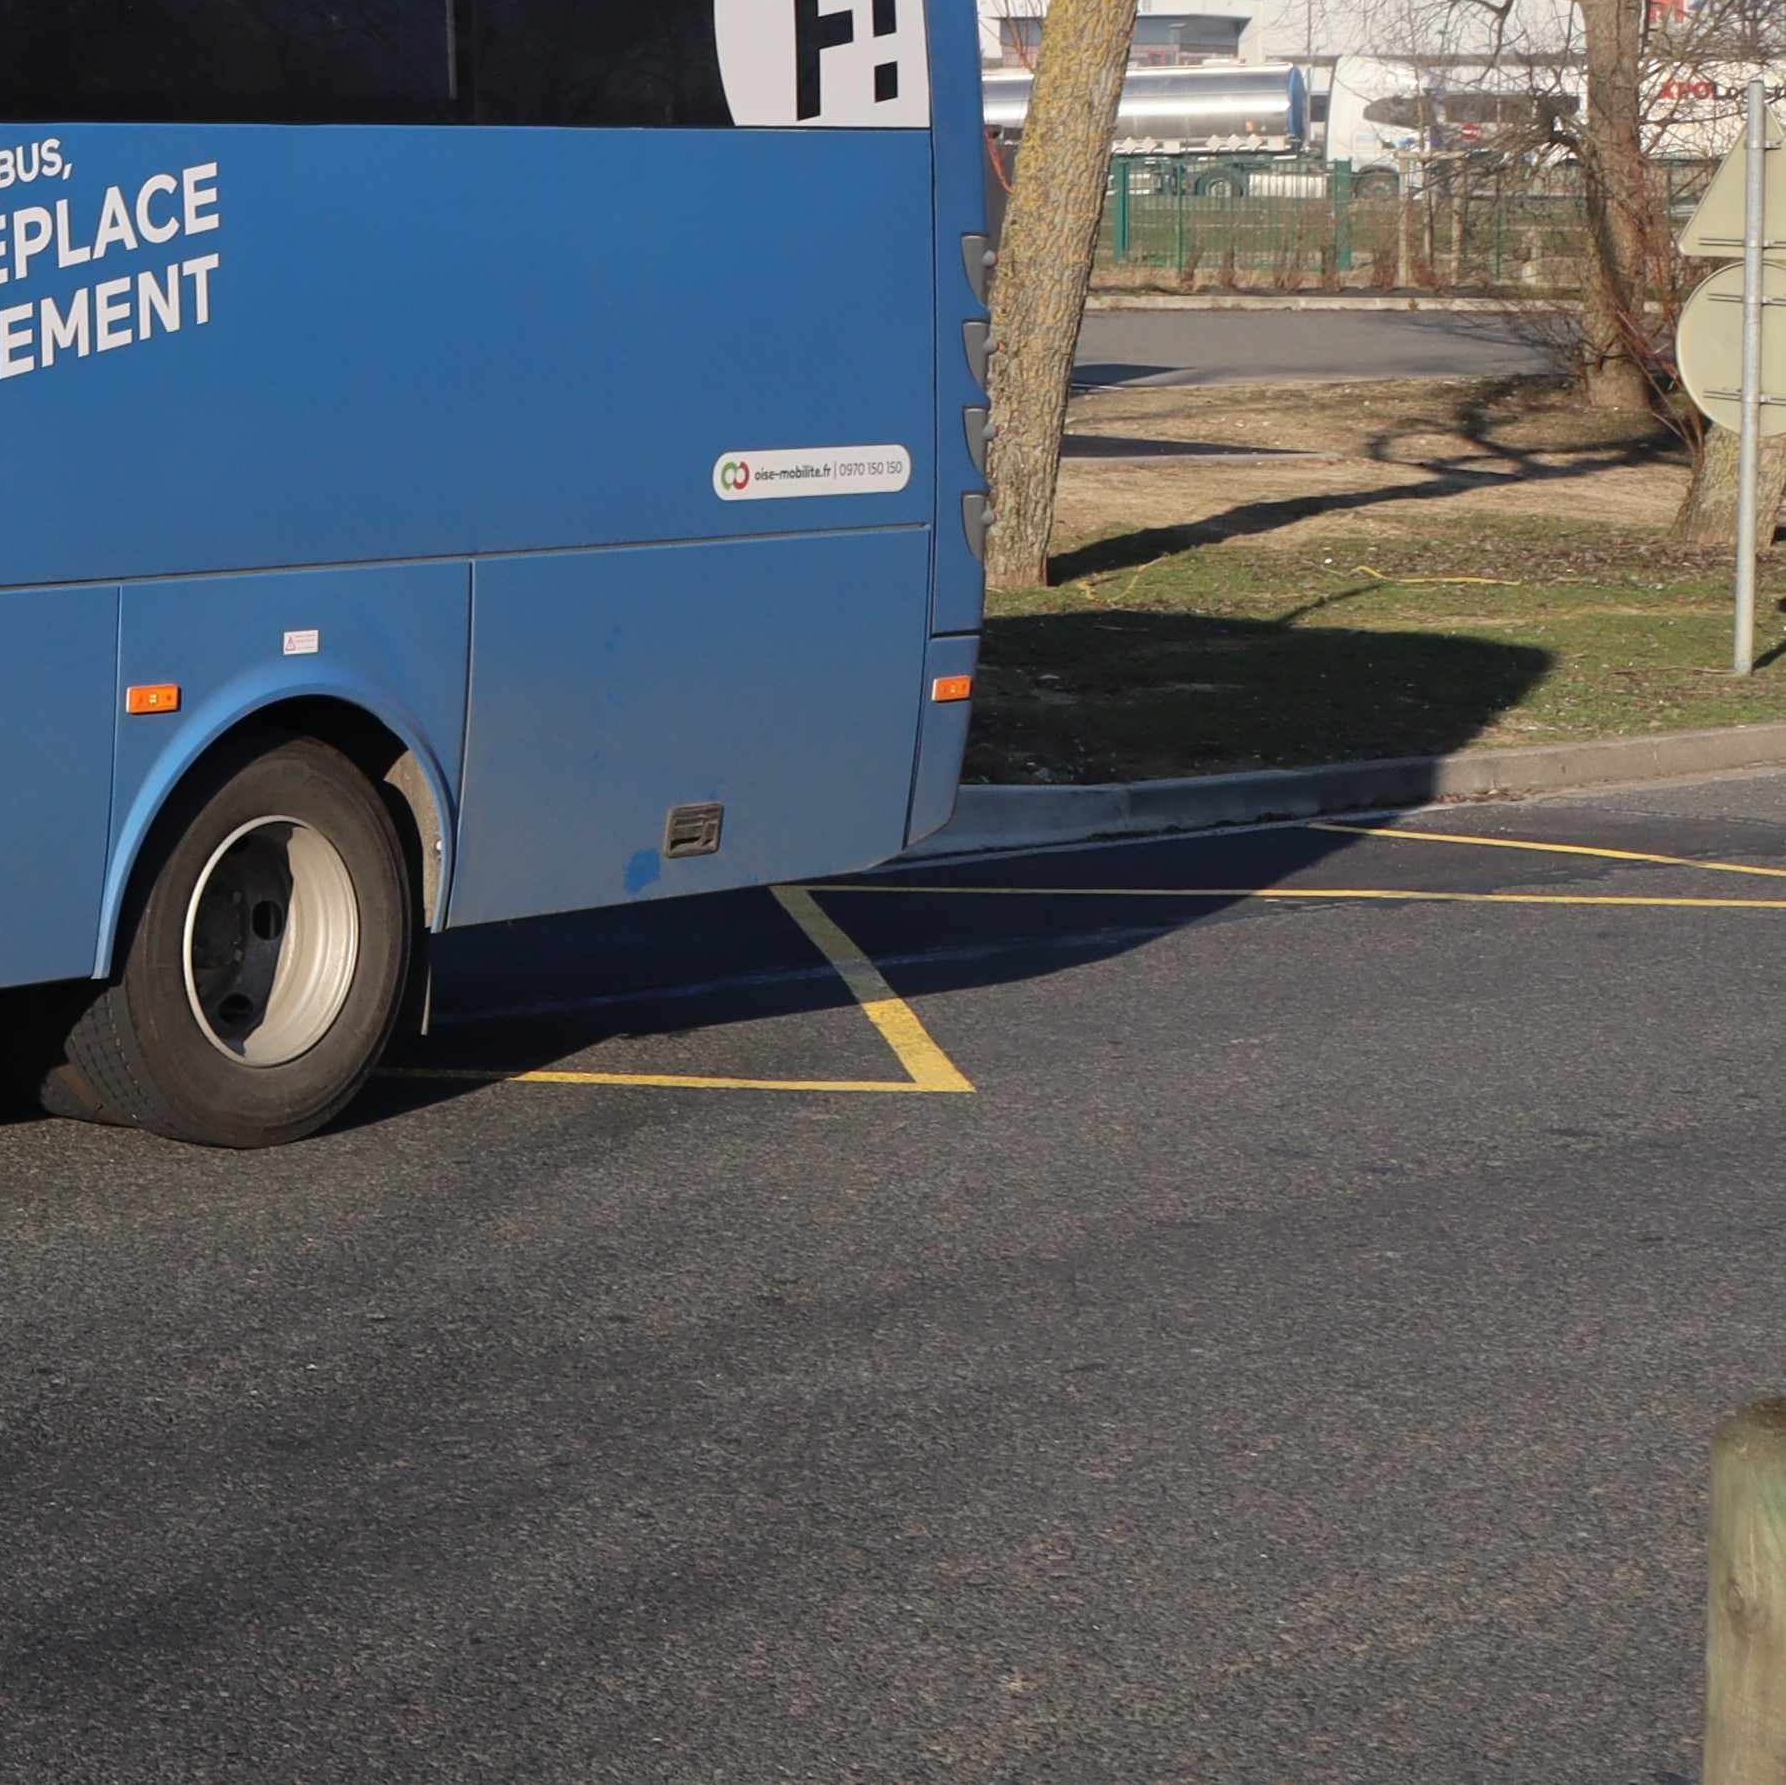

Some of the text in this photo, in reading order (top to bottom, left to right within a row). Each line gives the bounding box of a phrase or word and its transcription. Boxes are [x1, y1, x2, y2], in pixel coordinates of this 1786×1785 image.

[839, 462, 864, 477] 0970
[867, 461, 884, 475] 150
[886, 460, 903, 475] 150
